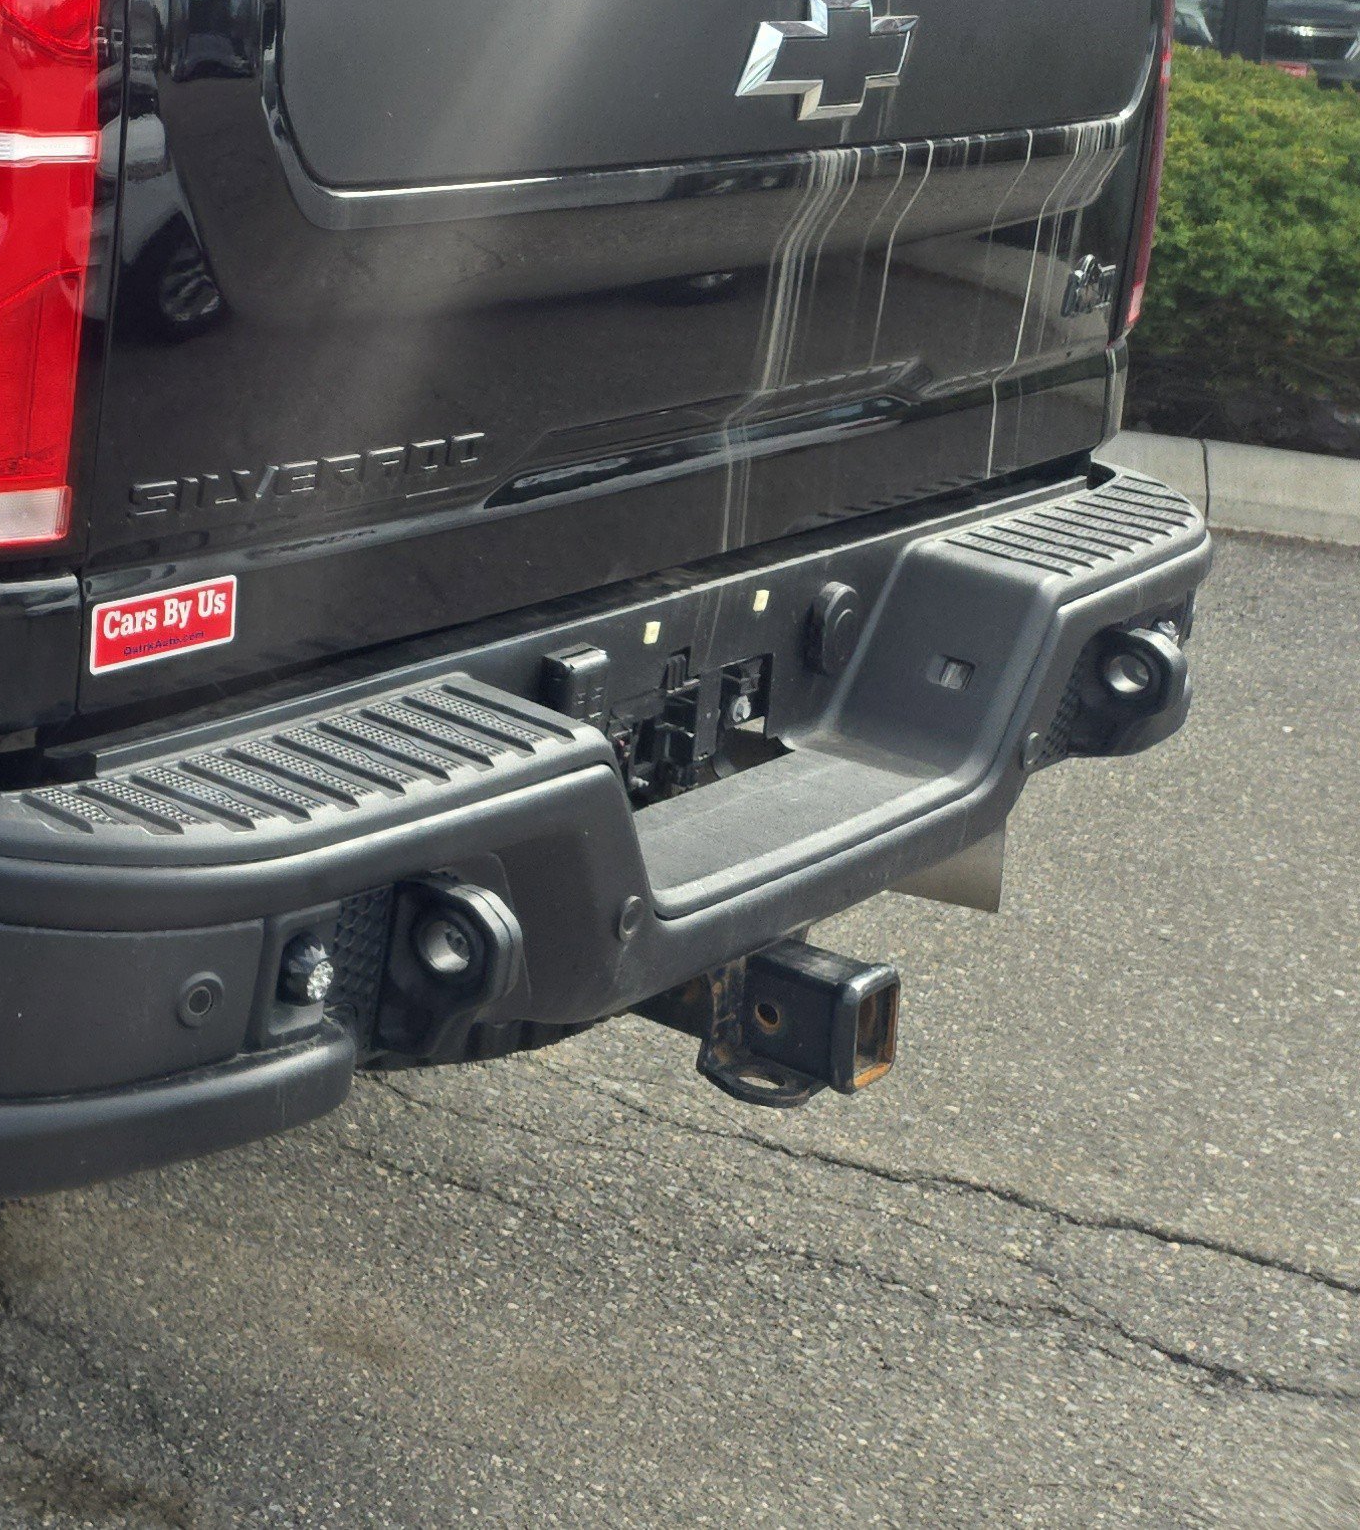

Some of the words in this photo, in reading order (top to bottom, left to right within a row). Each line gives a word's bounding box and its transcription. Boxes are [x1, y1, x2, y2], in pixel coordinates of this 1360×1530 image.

[130, 432, 485, 517] SILVERADO
[103, 608, 157, 640] Cars
[162, 597, 193, 629] By
[197, 589, 227, 618] Us
